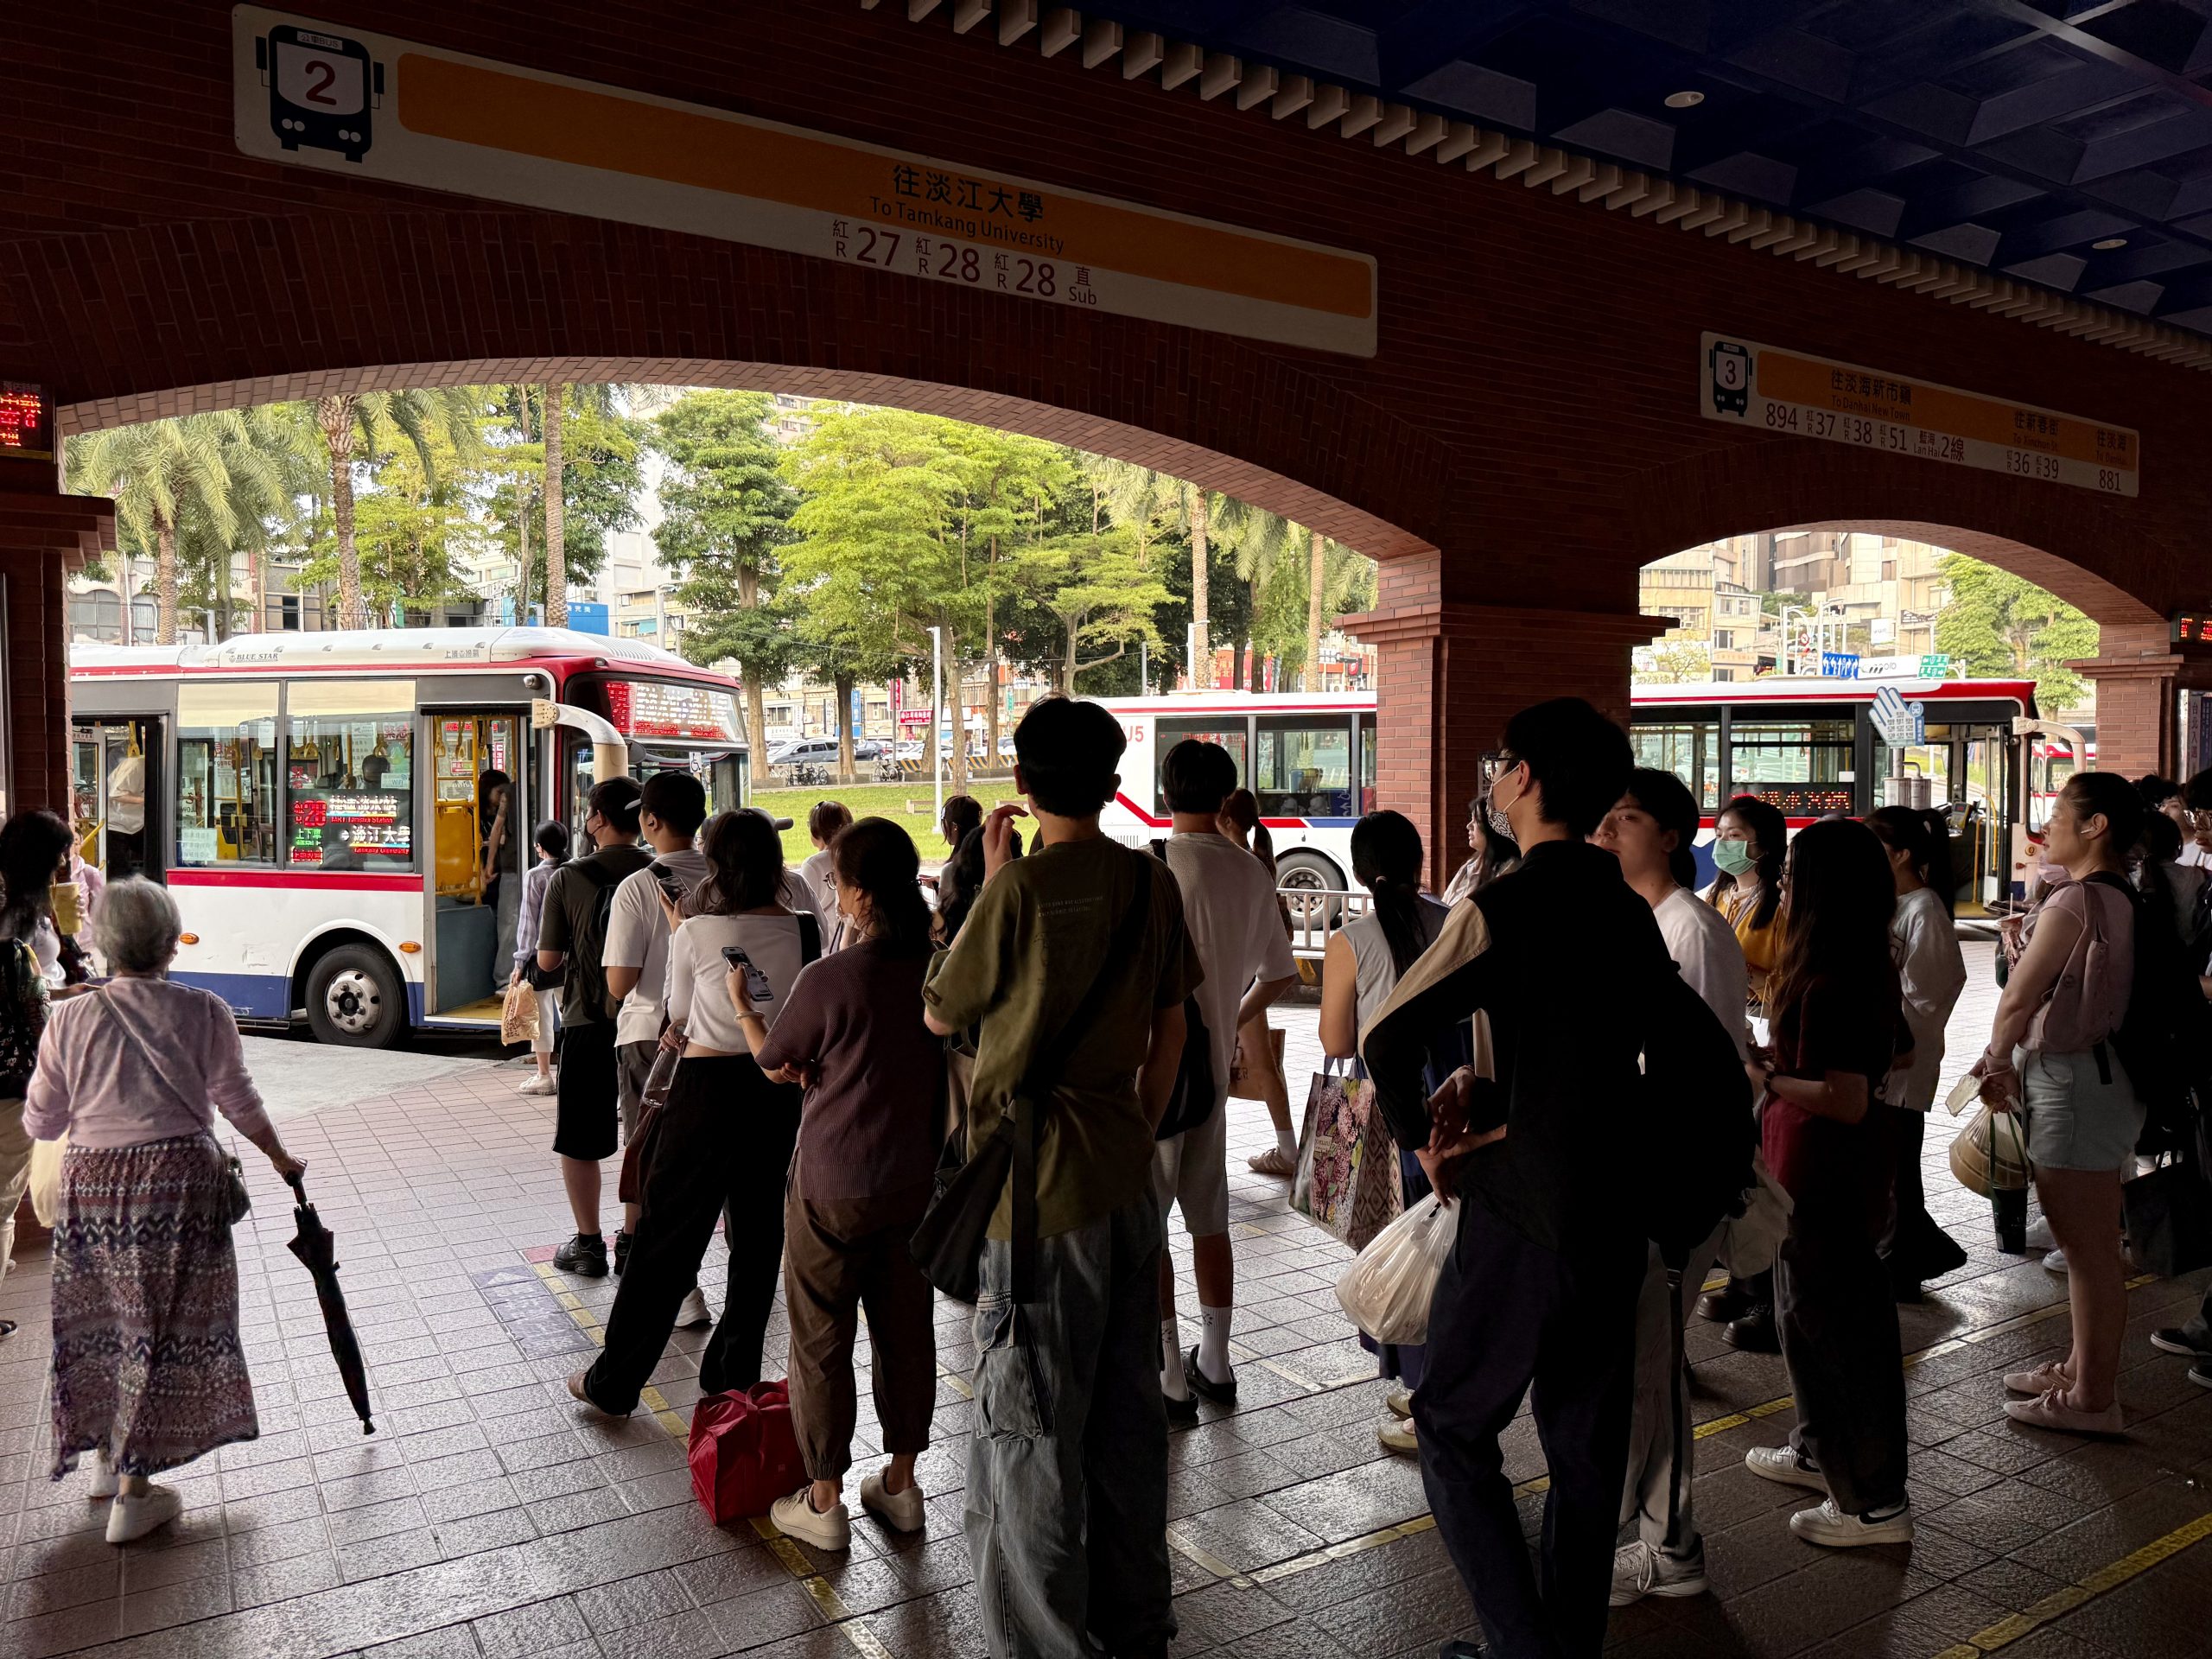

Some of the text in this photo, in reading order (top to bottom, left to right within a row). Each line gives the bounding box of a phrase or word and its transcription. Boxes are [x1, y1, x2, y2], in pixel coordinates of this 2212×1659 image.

[305, 60, 337, 105] 2
[893, 164, 1044, 223] 往淡江大學
[870, 196, 1065, 255] To Tamkang University
[832, 219, 1091, 297] 紅 27 紅 28 紅 28 直
[836, 241, 1097, 306] R R R Sub
[1725, 359, 1737, 385] 3
[1831, 369, 1912, 406] 往淡海新市鎮
[1832, 394, 1910, 422] To Danhai New Town
[1766, 403, 1798, 431] 894
[1816, 412, 1835, 437] 37
[1853, 420, 1872, 444] 38
[1890, 427, 1907, 451] 51
[2014, 452, 2030, 474] 36
[2044, 457, 2059, 479] 39
[2099, 469, 2121, 492] 881
